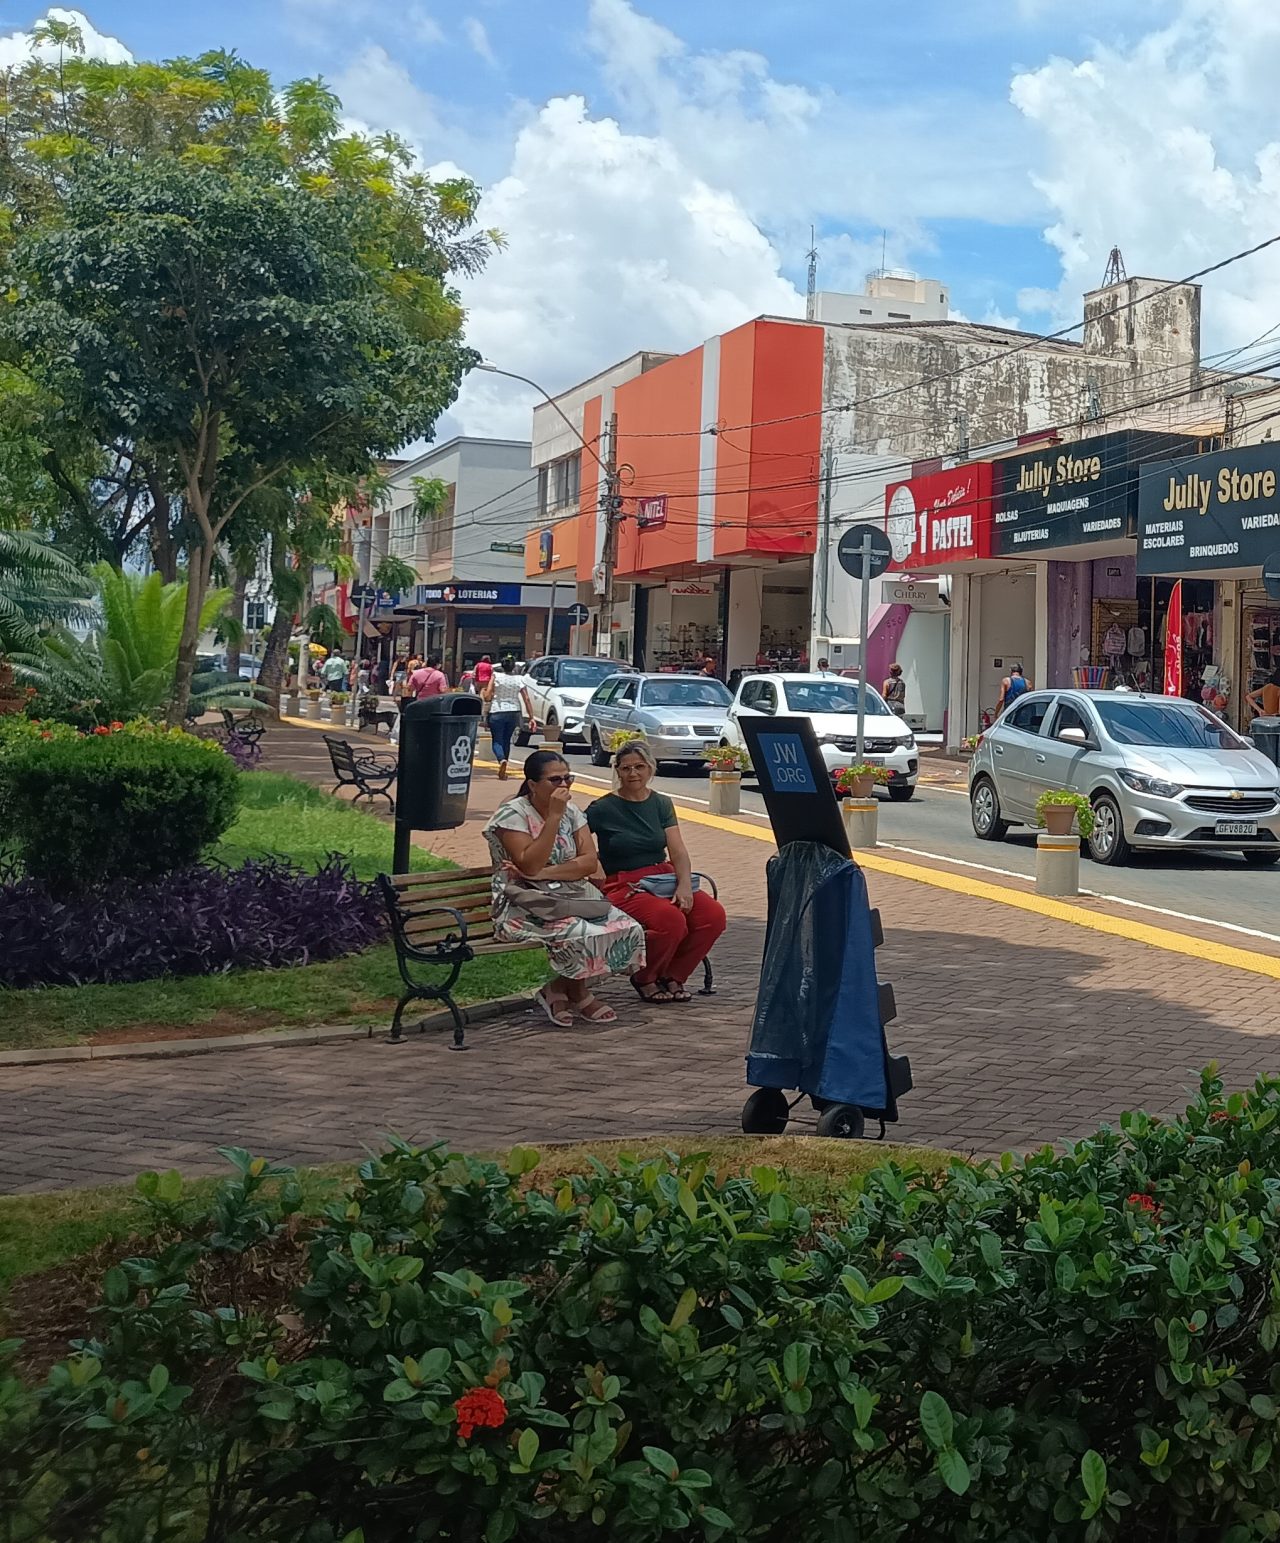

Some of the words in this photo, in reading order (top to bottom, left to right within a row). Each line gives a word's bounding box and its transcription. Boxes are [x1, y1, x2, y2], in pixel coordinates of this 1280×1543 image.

[1016, 463, 1052, 498] Jully
[1056, 453, 1101, 487] Store
[1163, 473, 1212, 515] Jully
[1217, 467, 1276, 504] Store
[1046, 497, 1090, 515] MAQUIAGENS
[995, 509, 1019, 523] BOLSAS
[931, 514, 974, 552] PASTEL
[1082, 517, 1122, 533] VARIEDADES
[1145, 520, 1184, 535] MATERIAIS
[1013, 528, 1049, 543] BIJUTERIAS
[1143, 534, 1185, 549] ESCOLARES
[1189, 541, 1239, 558] BRINQUEDOS
[458, 589, 498, 600] LOTERIAS
[893, 588, 927, 599] CHERRY
[773, 742, 798, 764] JW
[777, 767, 807, 784] .ORG
